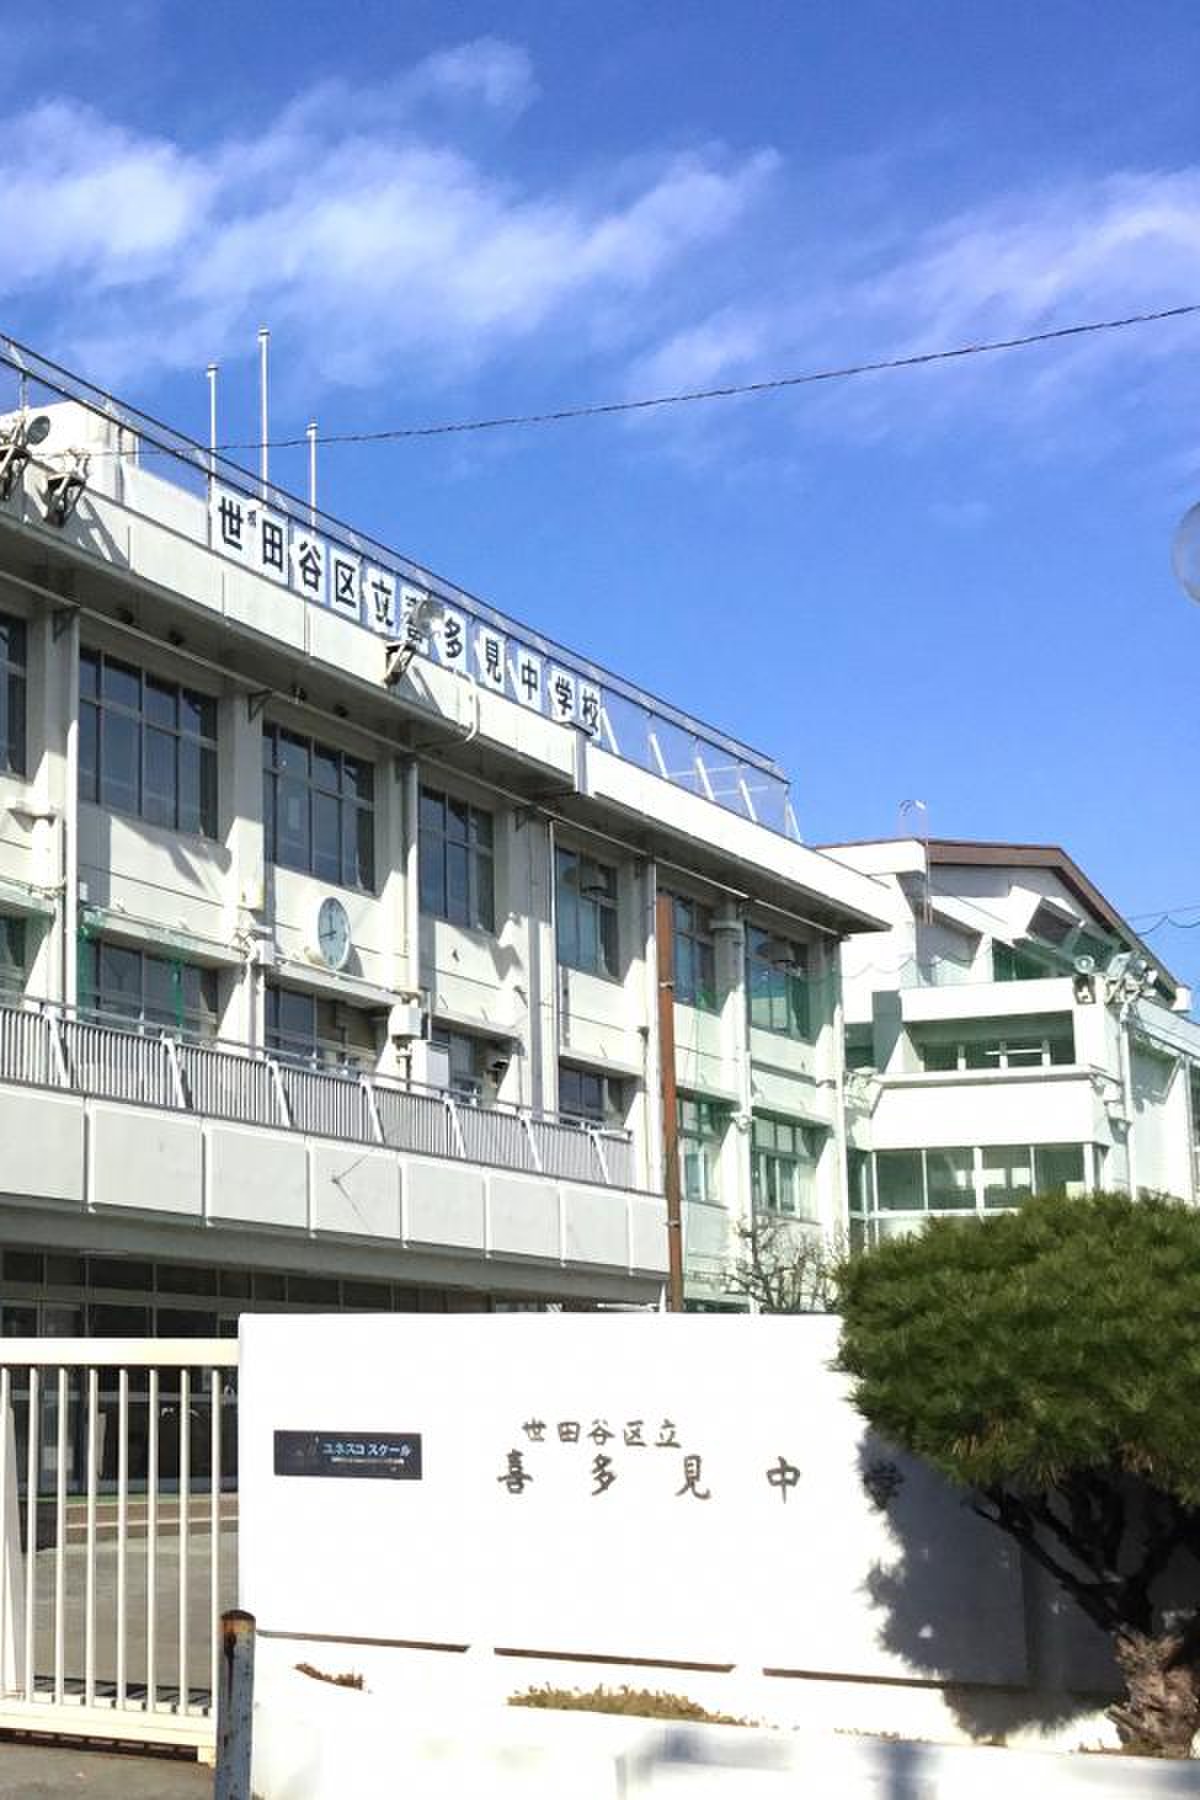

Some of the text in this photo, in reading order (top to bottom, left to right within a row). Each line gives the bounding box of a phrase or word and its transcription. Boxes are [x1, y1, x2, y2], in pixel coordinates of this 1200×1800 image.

[522, 1418, 682, 1449] 世田谷区立
